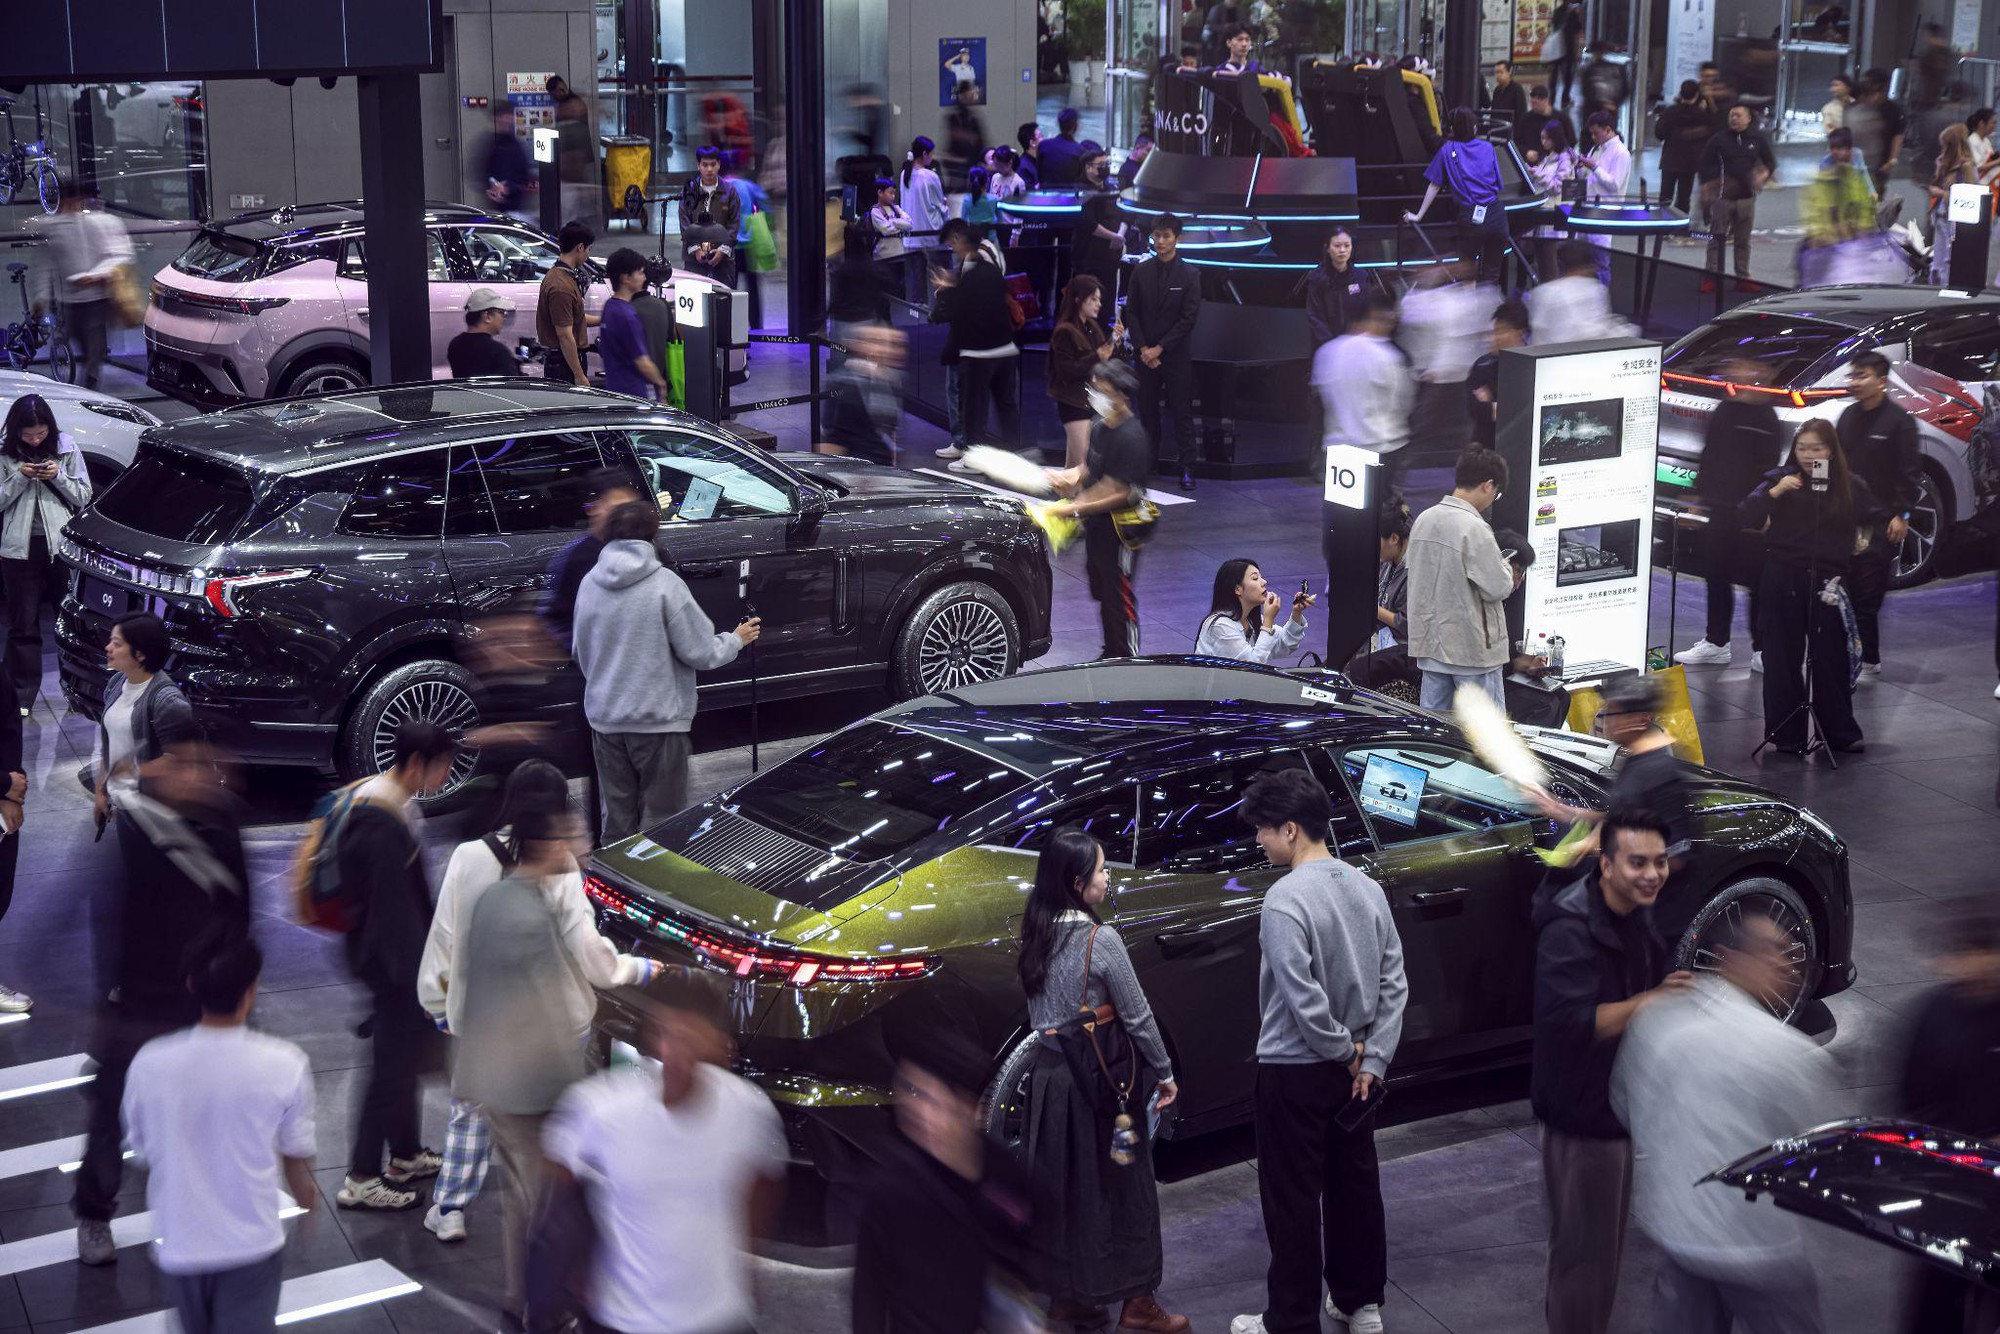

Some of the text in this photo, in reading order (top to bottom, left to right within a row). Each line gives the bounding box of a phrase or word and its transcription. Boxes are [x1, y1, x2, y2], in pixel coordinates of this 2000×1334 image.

[536, 140, 546, 151] 06
[679, 296, 694, 312] 09
[755, 398, 789, 410] LYNK&CO
[1331, 465, 1355, 488] 10
[102, 593, 113, 607] 09
